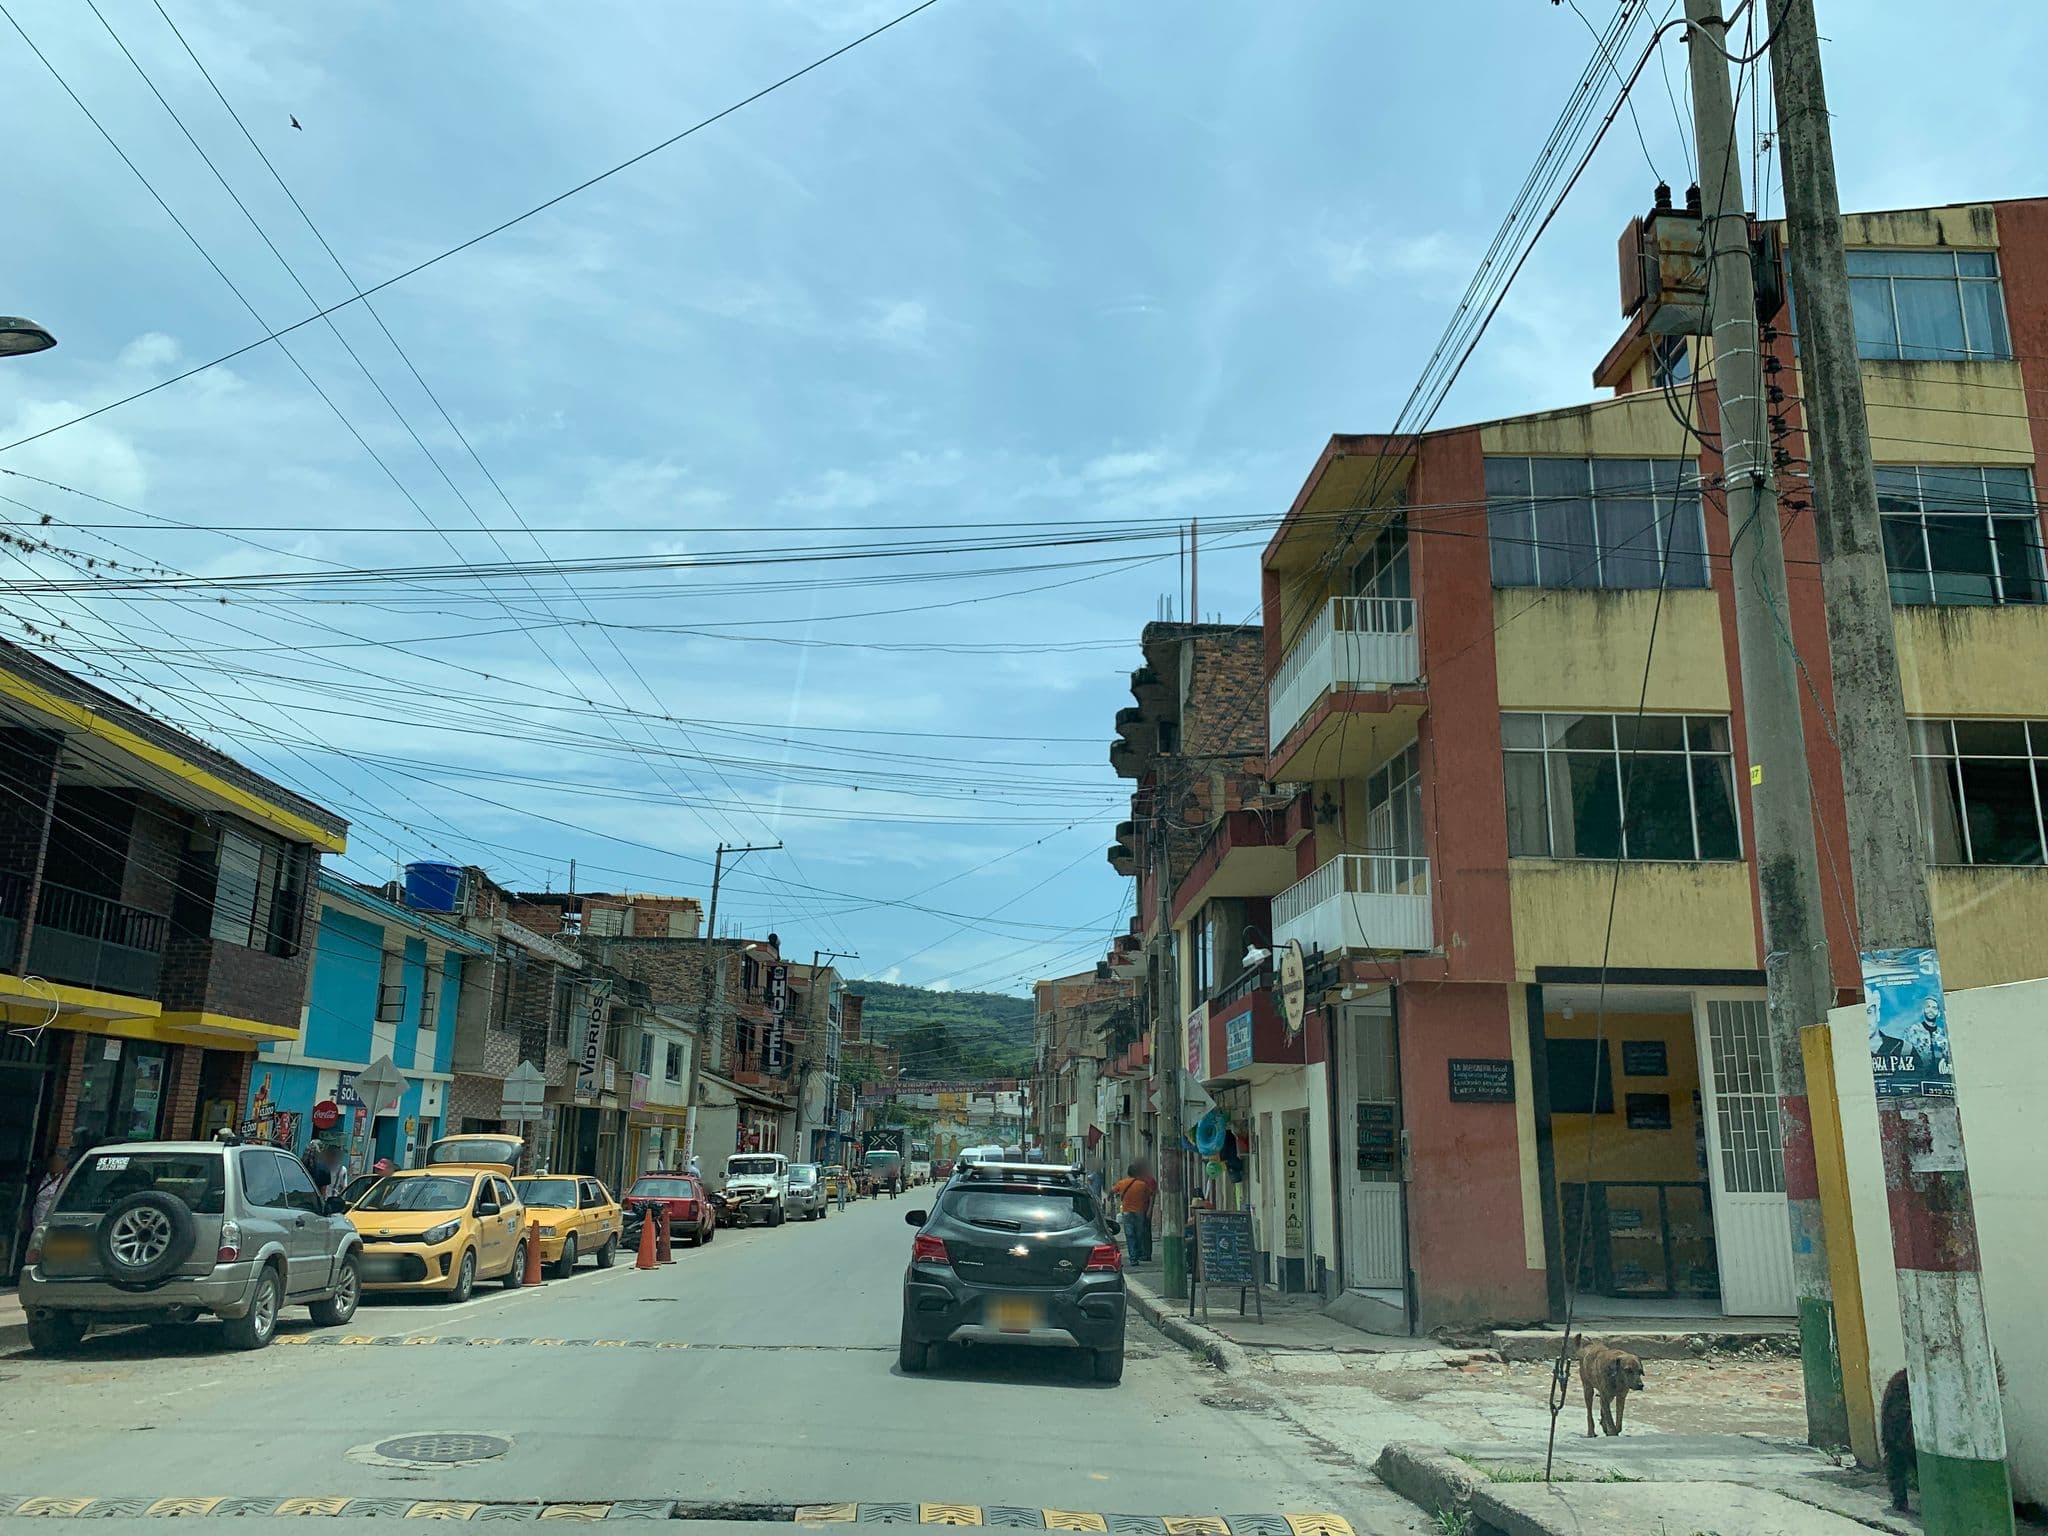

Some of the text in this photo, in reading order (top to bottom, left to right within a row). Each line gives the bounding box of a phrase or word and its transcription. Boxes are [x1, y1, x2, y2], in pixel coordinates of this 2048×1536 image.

[579, 996, 605, 1077] VIDRIOS
[769, 980, 786, 1066] HOTEL
[1890, 1055, 1916, 1073] PAZ
[313, 1110, 337, 1120] Coca-Cola
[1287, 1128, 1298, 1221] RELOJERIA
